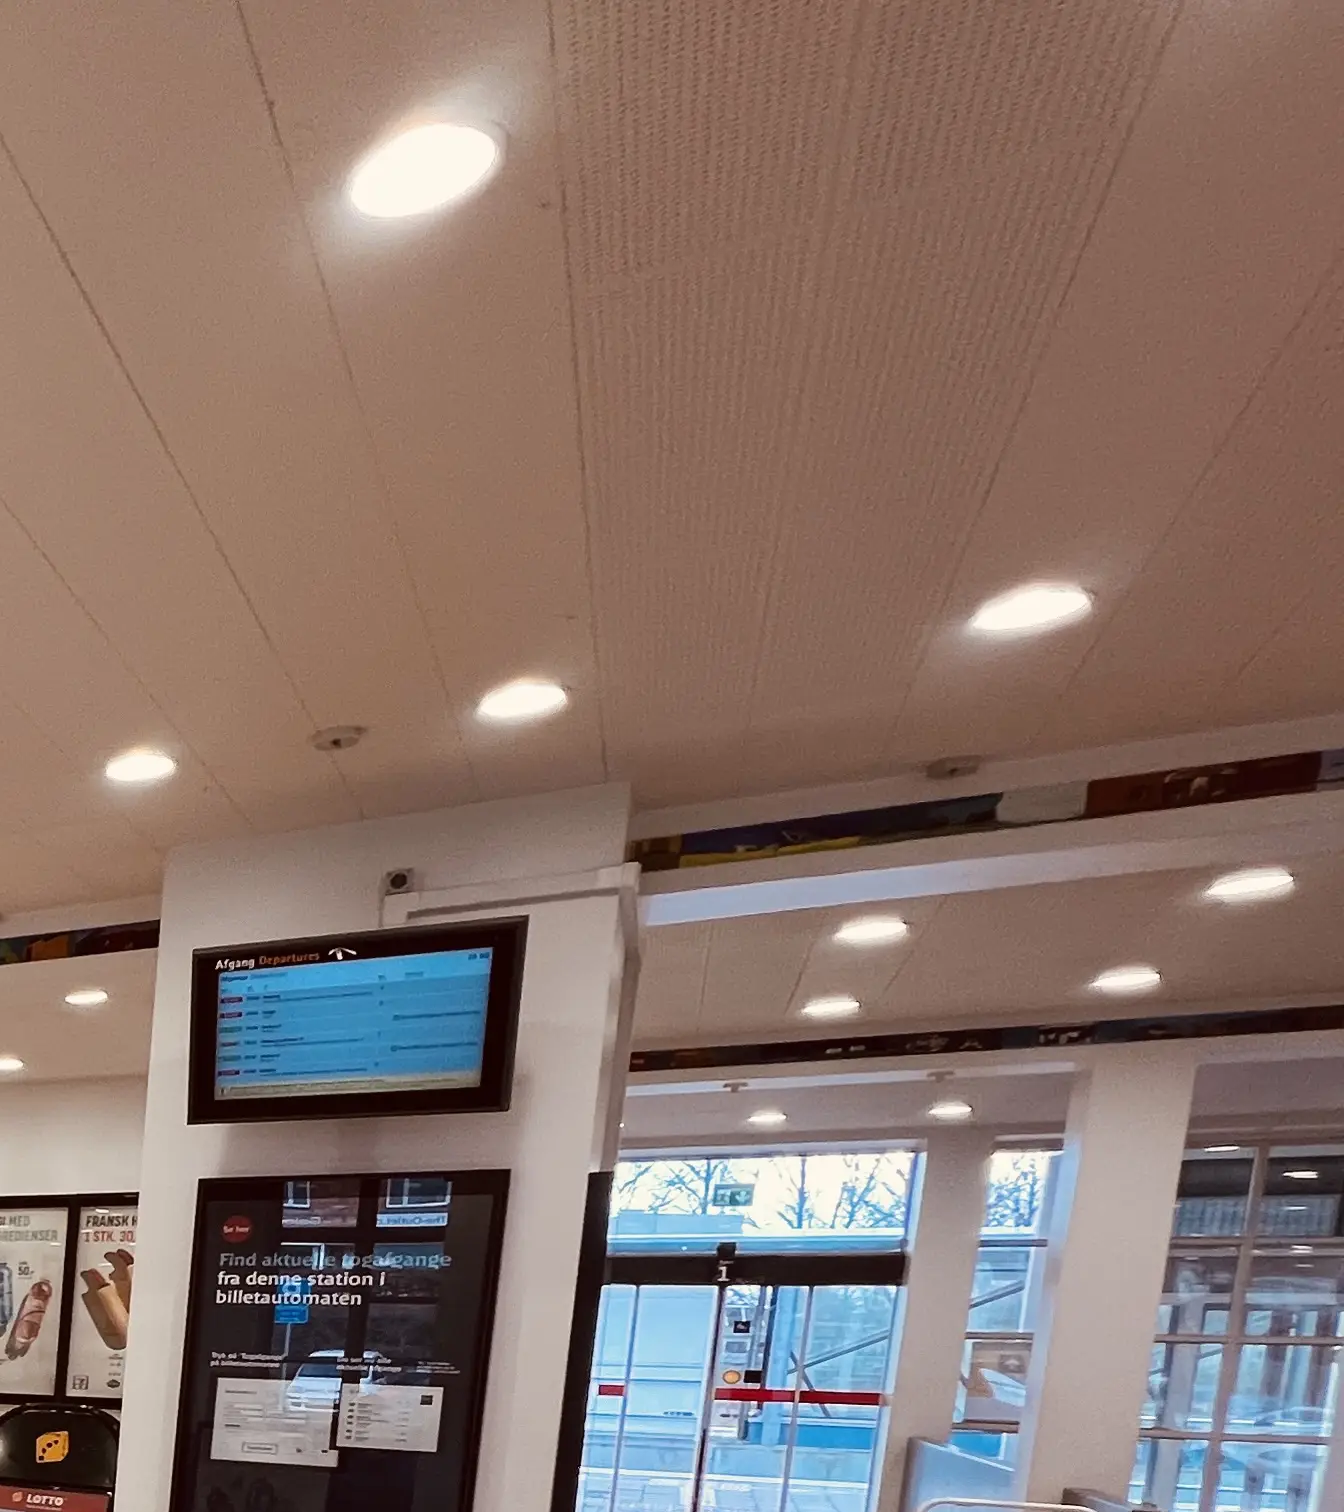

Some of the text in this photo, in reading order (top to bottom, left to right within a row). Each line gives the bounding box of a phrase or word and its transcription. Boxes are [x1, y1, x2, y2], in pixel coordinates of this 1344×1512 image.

[215, 953, 320, 970] Afgang Departures
[6, 1214, 31, 1227] MED
[85, 1215, 130, 1228] FRANSK
[219, 1251, 452, 1270] Find aktuelle togafgange
[217, 1271, 240, 1286] fra
[246, 1271, 301, 1286] denne
[307, 1272, 373, 1286] station
[717, 1265, 731, 1282] 1
[215, 1290, 362, 1306] billetautomaten
[26, 1493, 64, 1506] LOTTO
